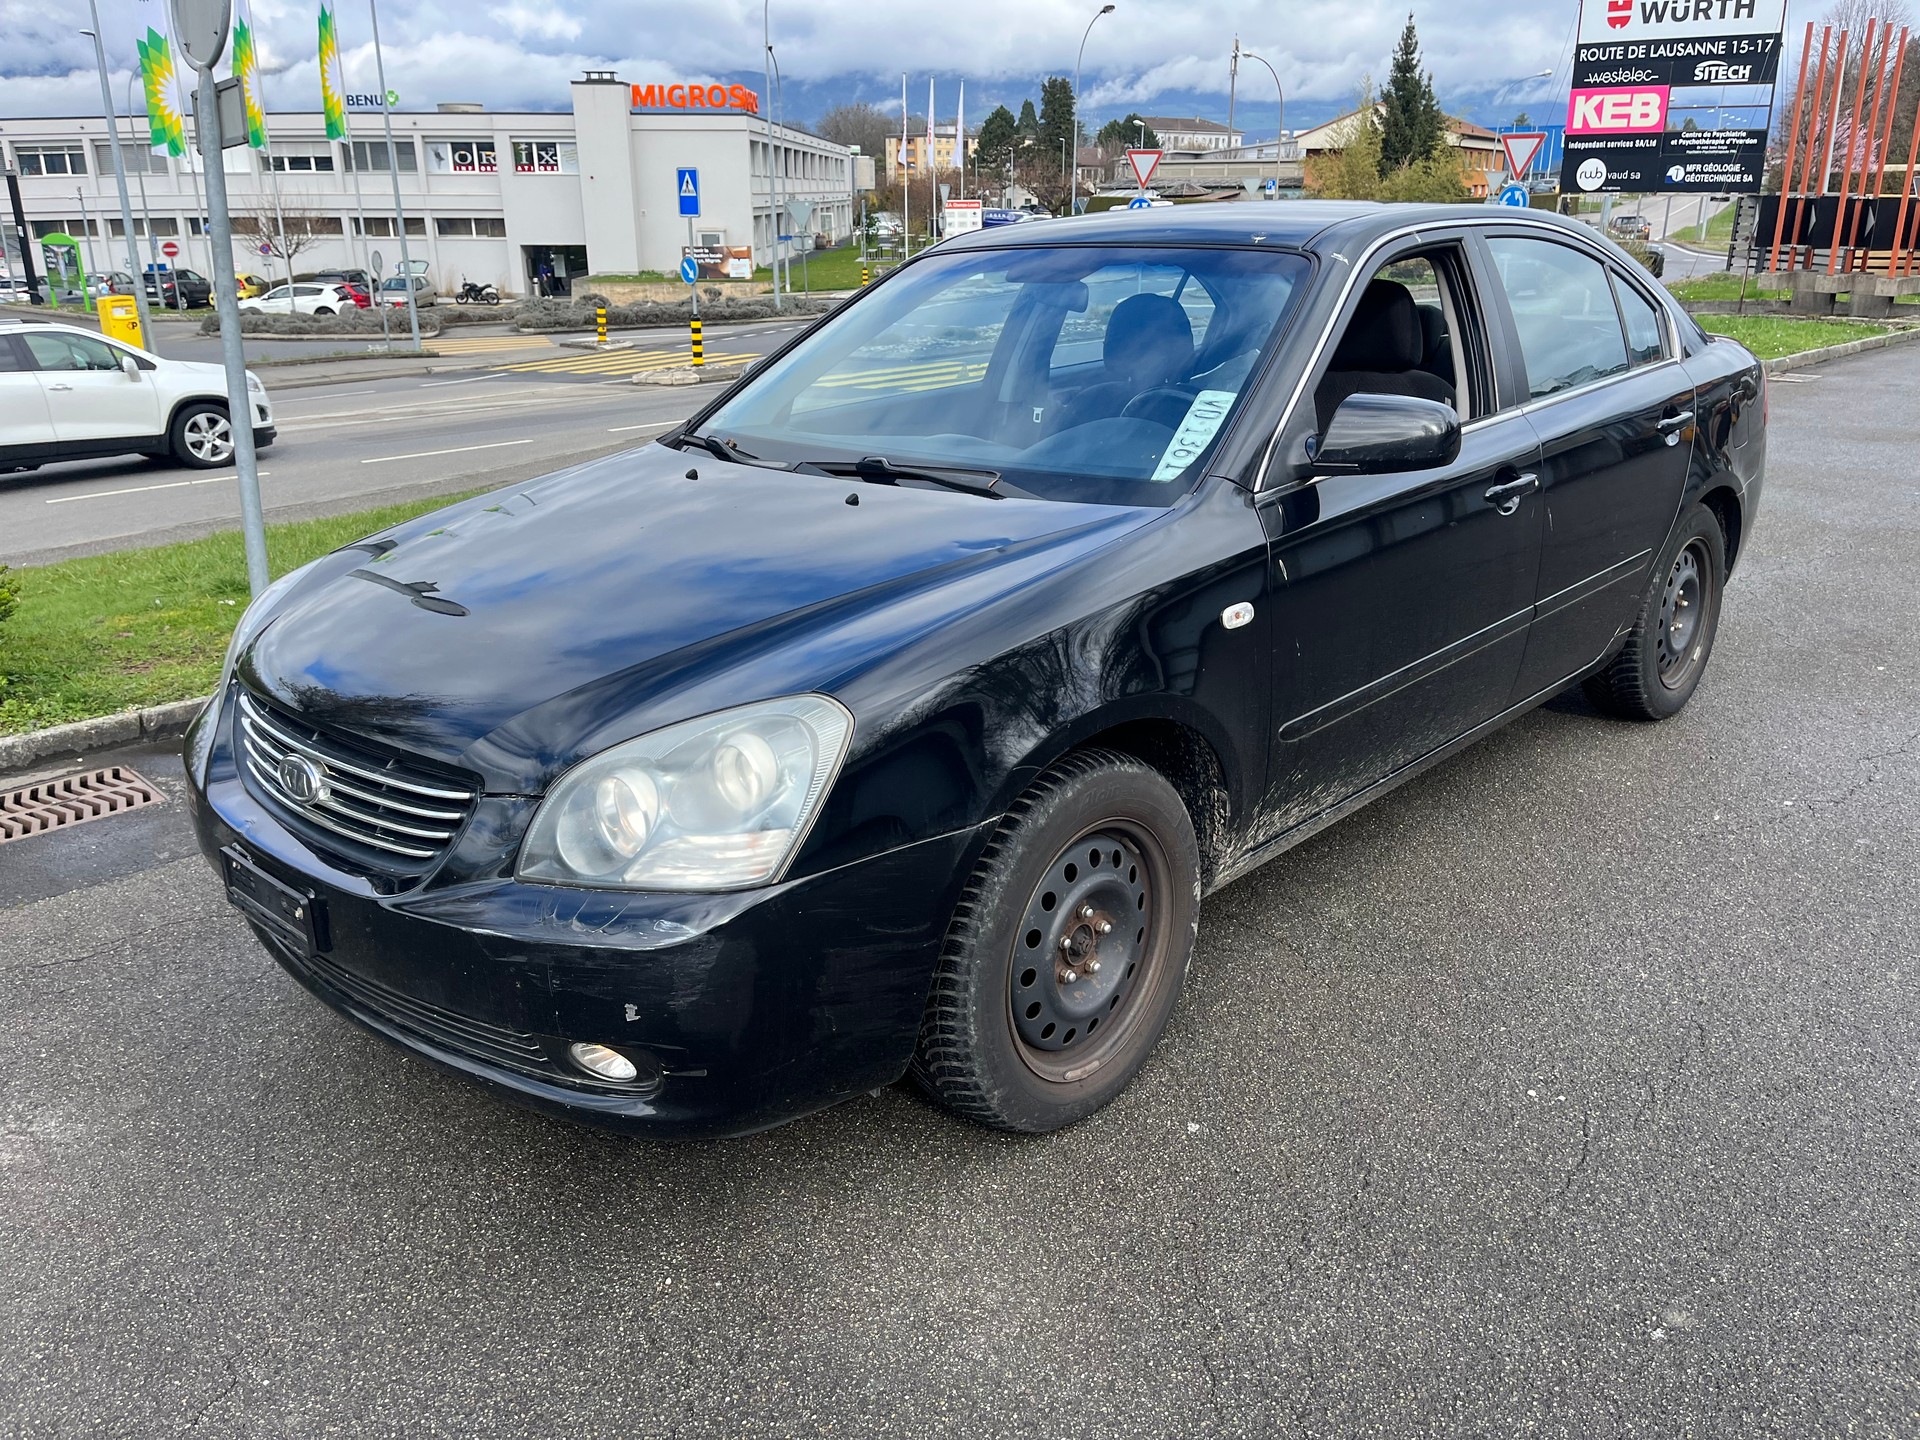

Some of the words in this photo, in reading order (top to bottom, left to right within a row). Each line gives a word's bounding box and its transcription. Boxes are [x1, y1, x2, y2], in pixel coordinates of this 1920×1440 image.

[1641, 0, 1756, 24] WÜRTH
[1579, 46, 1625, 62] ROUTE
[1627, 45, 1646, 59] DE
[1650, 41, 1727, 58] LAUSANNE
[1731, 38, 1775, 54] 15-17
[1694, 63, 1752, 82] SITECH
[346, 94, 383, 106] BENU
[631, 83, 747, 108] MIGROS
[1572, 93, 1661, 129] KEB
[1712, 131, 1747, 139] Psychiatrie
[1607, 140, 1633, 148] services
[1685, 164, 1702, 172] MFR
[1702, 162, 1741, 172] GÉOLOGIE
[1607, 170, 1628, 179] vaud
[1630, 171, 1641, 179] sa
[1684, 173, 1742, 183] GÉOTECHNIQUE
[1742, 174, 1753, 182] SA
